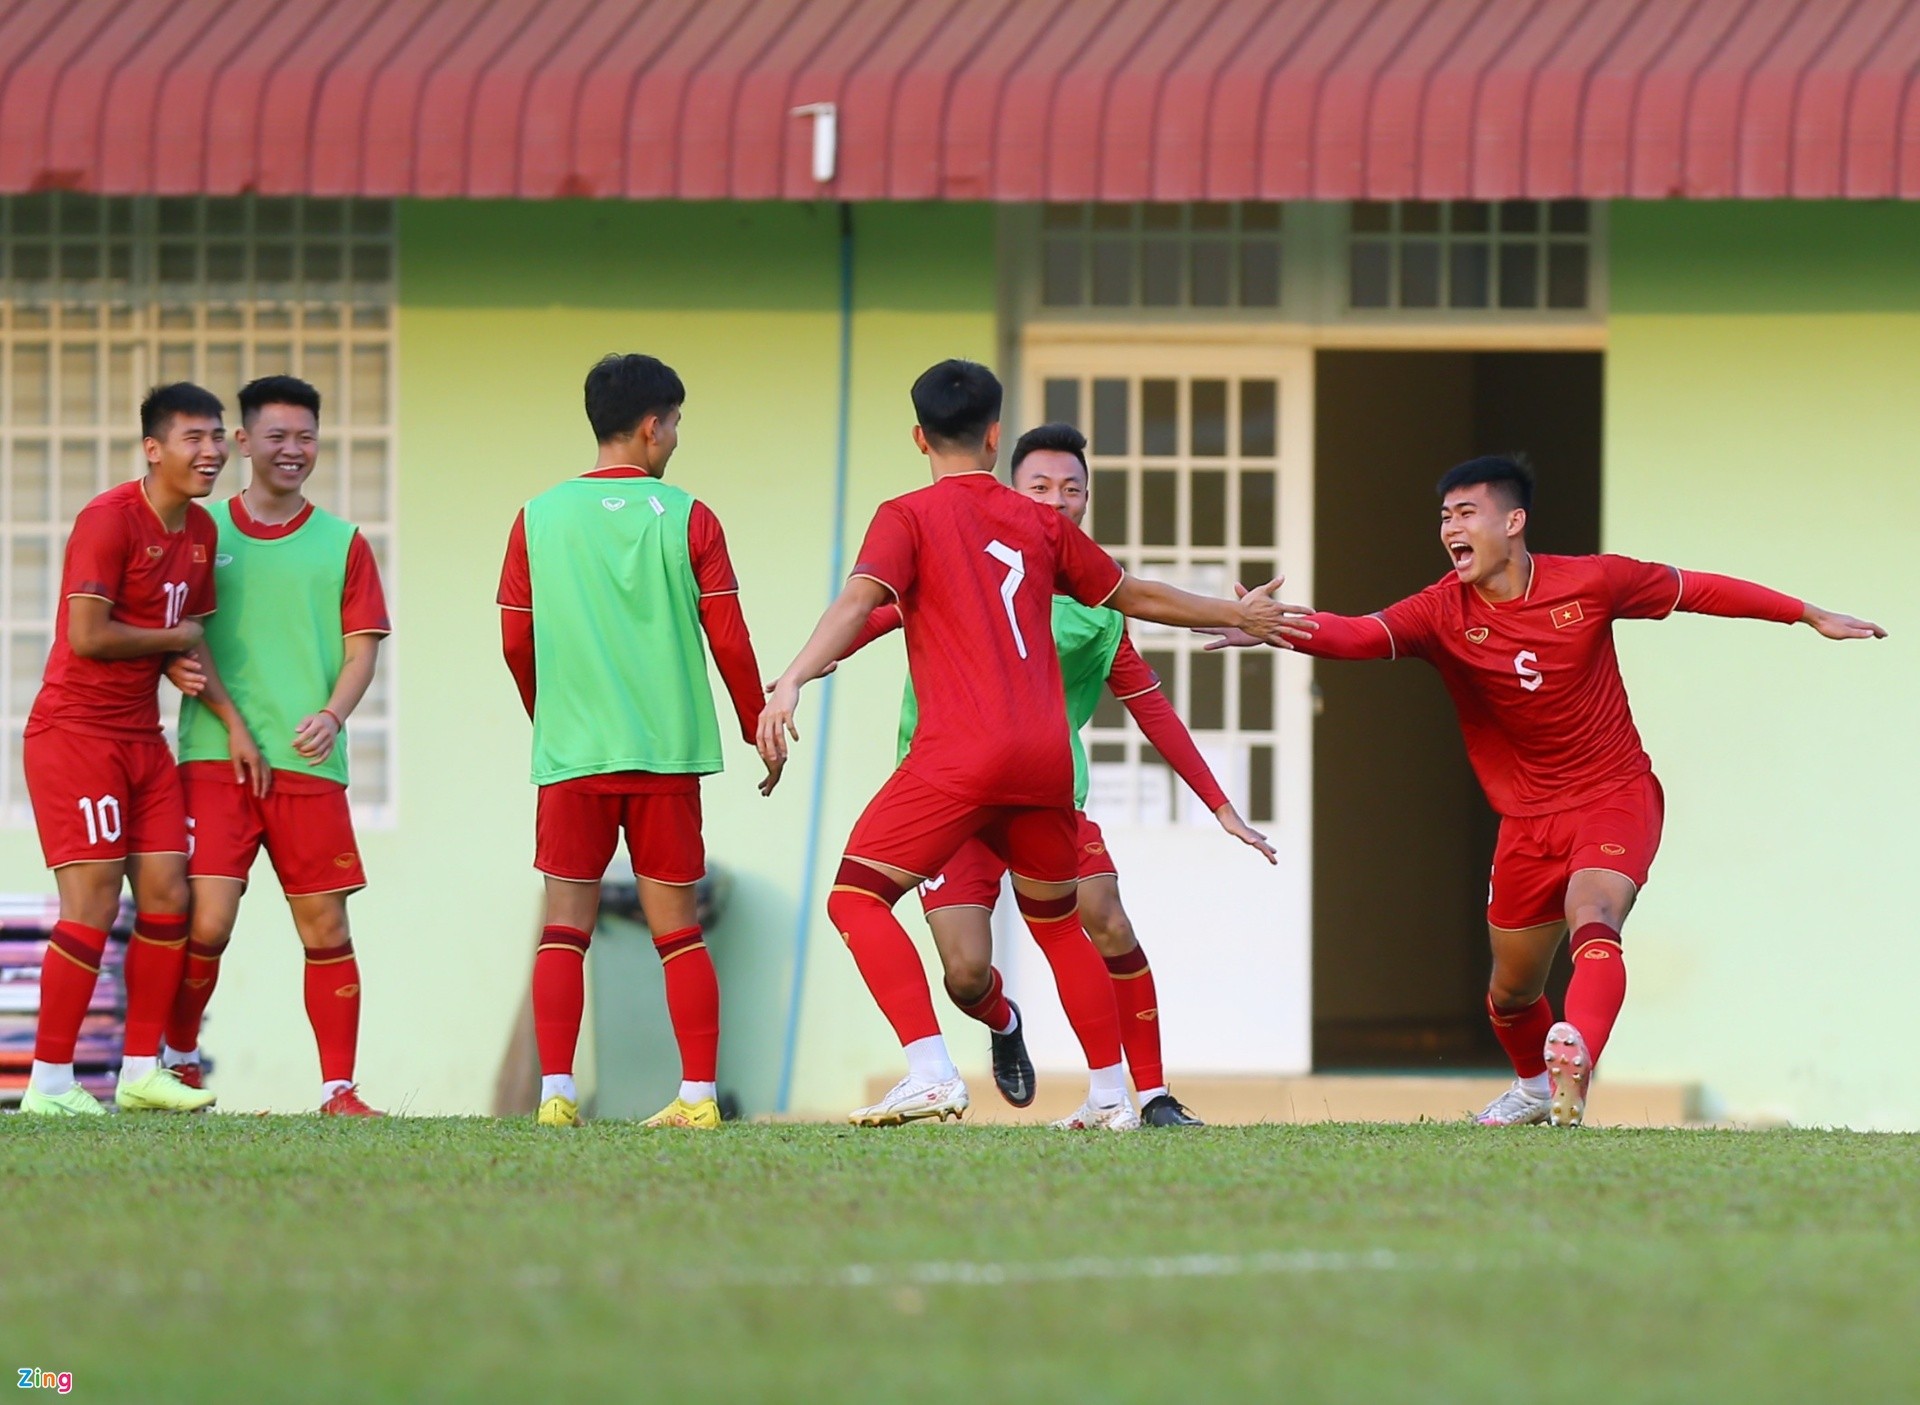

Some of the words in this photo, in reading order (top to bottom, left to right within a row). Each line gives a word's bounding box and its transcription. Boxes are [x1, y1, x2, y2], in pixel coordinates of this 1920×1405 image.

[163, 581, 189, 628] 10
[983, 539, 1028, 660] 7
[78, 794, 121, 845] 10
